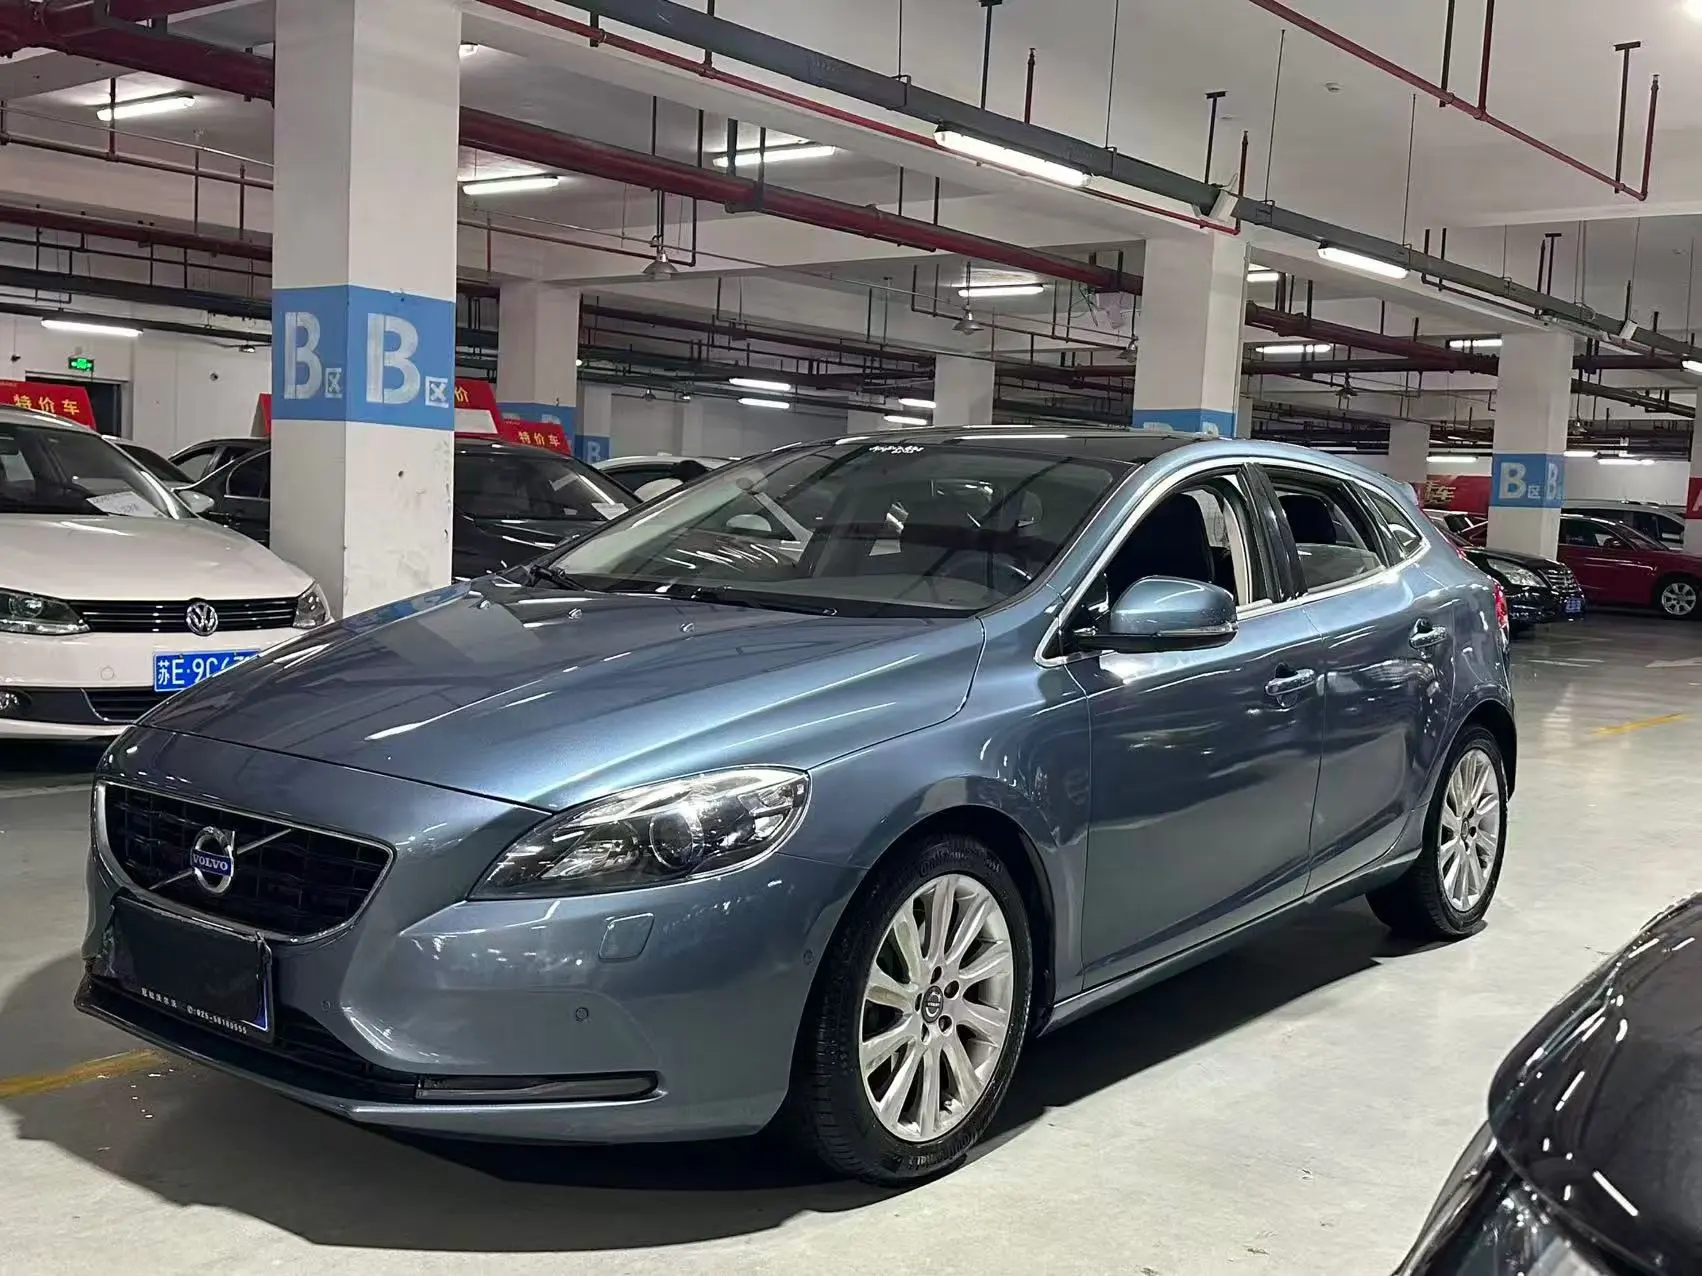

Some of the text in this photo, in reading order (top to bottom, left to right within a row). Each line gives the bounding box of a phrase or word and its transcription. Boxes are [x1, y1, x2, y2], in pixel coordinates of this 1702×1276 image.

[366, 312, 449, 408] B区
[13, 393, 80, 415] 特价车
[518, 431, 560, 447] 特价车
[193, 853, 228, 871] VOLVO
